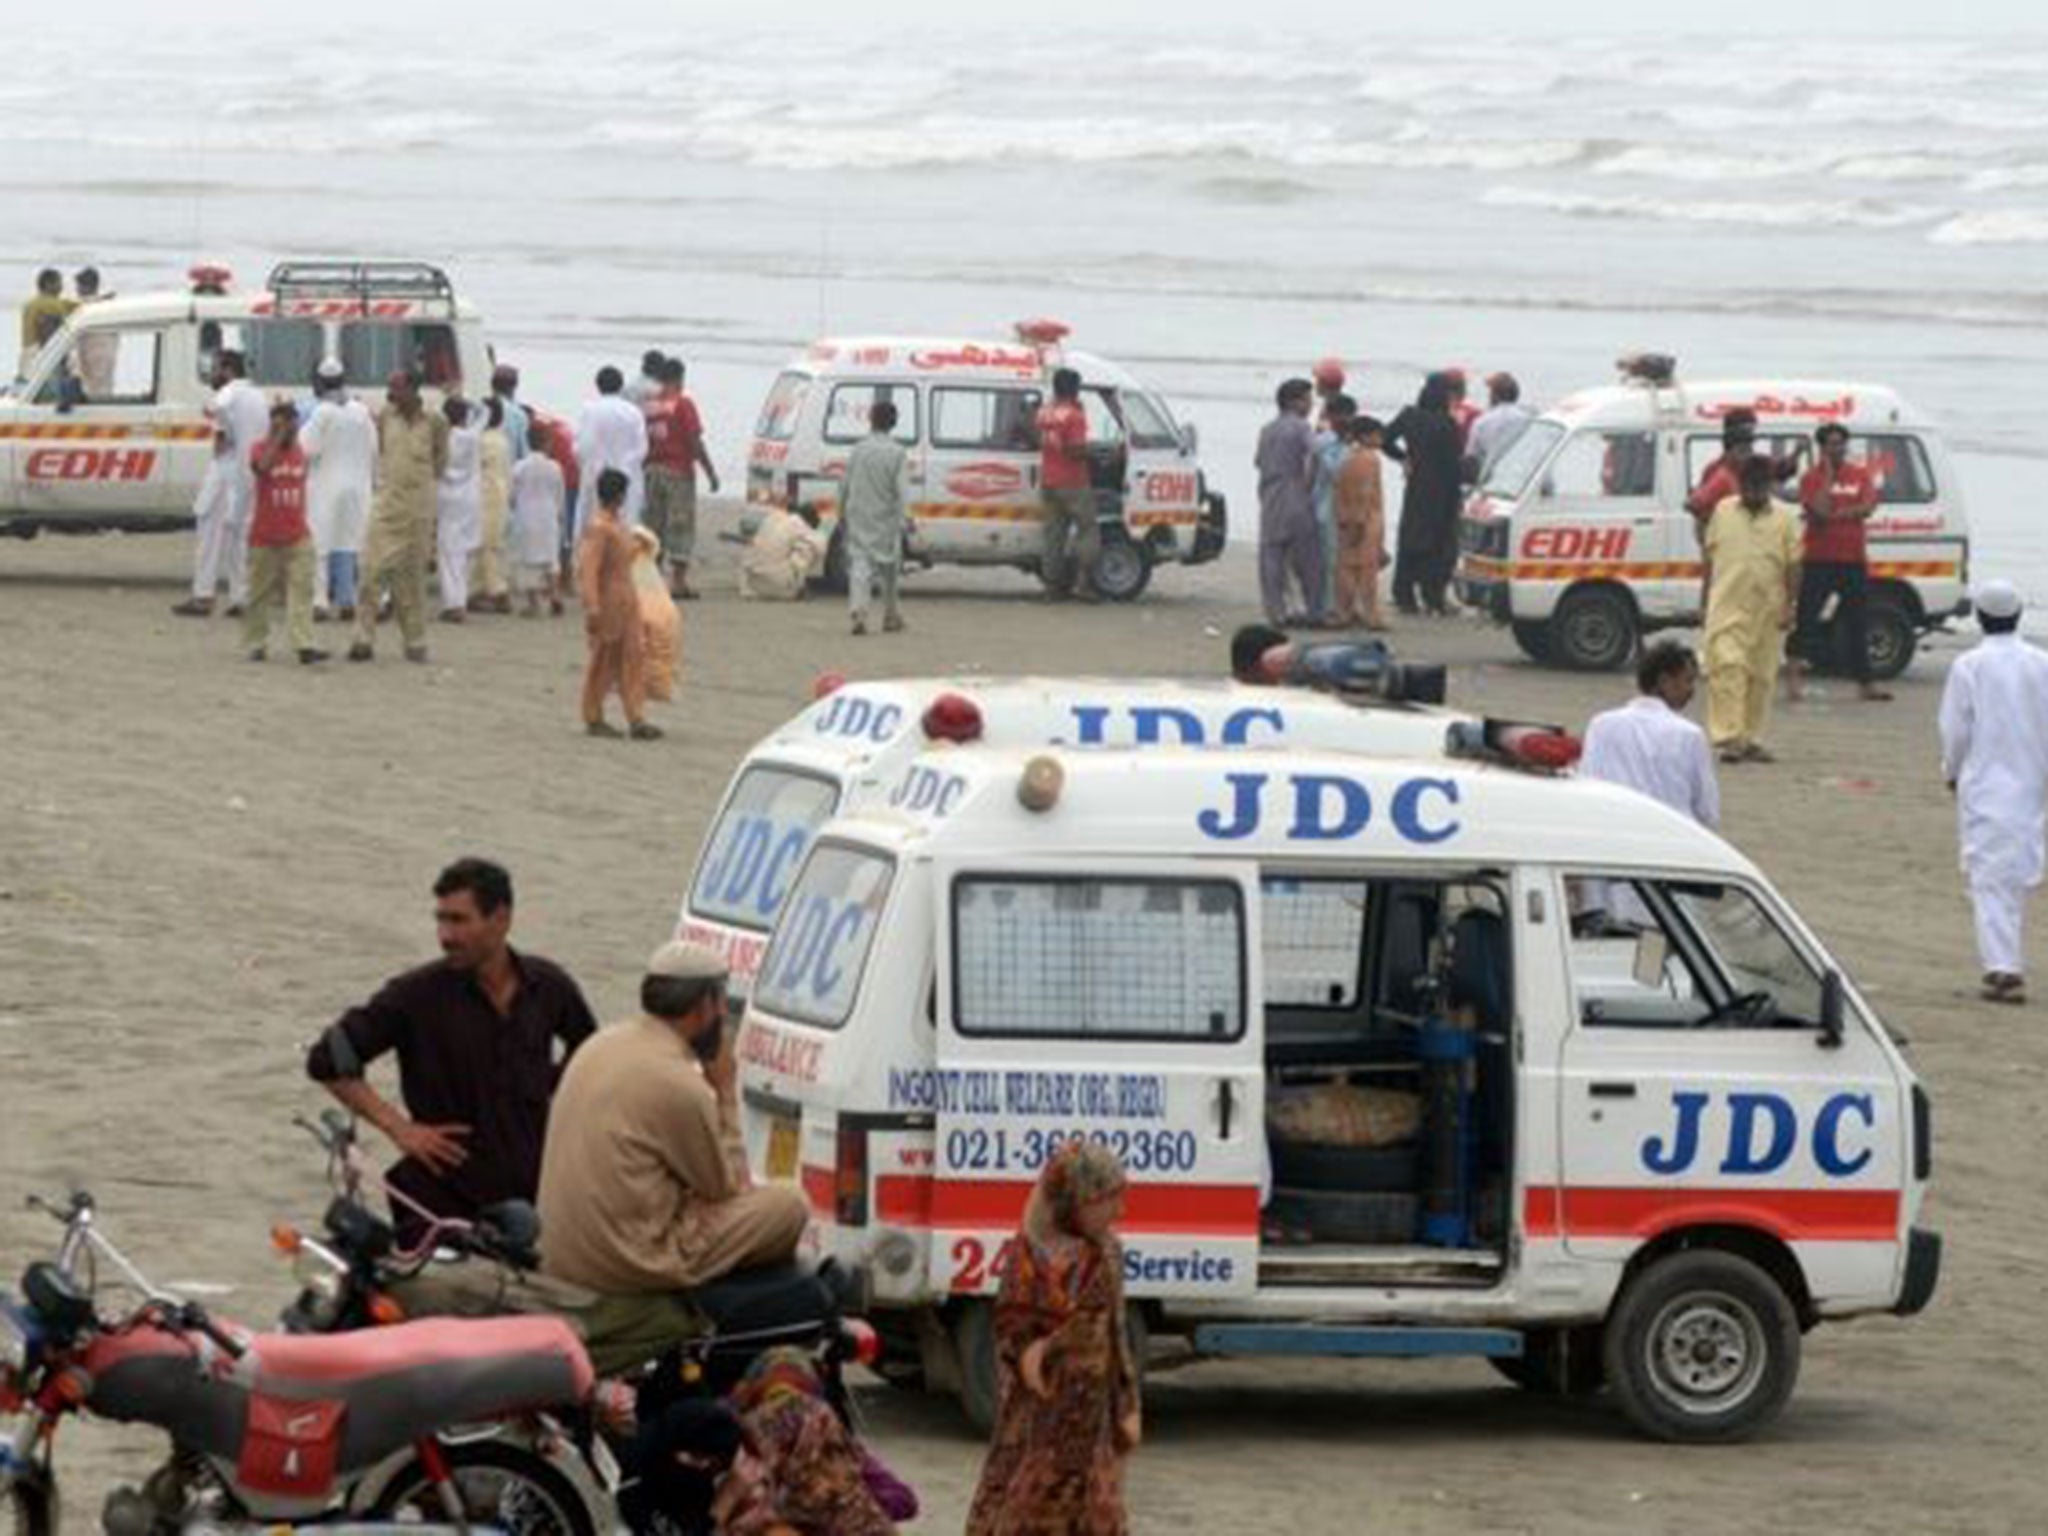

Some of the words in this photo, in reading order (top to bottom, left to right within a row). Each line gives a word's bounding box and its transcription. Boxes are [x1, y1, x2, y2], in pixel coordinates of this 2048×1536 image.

[27, 449, 156, 481] EDHI
[1146, 471, 1195, 503] EDHI
[1522, 526, 1632, 559] EDHI
[815, 697, 902, 743] JDC
[890, 765, 966, 817] JDC
[1197, 773, 1459, 843] JDC
[1641, 1091, 1876, 1176] JDC
[1122, 1249, 1233, 1282] Service
